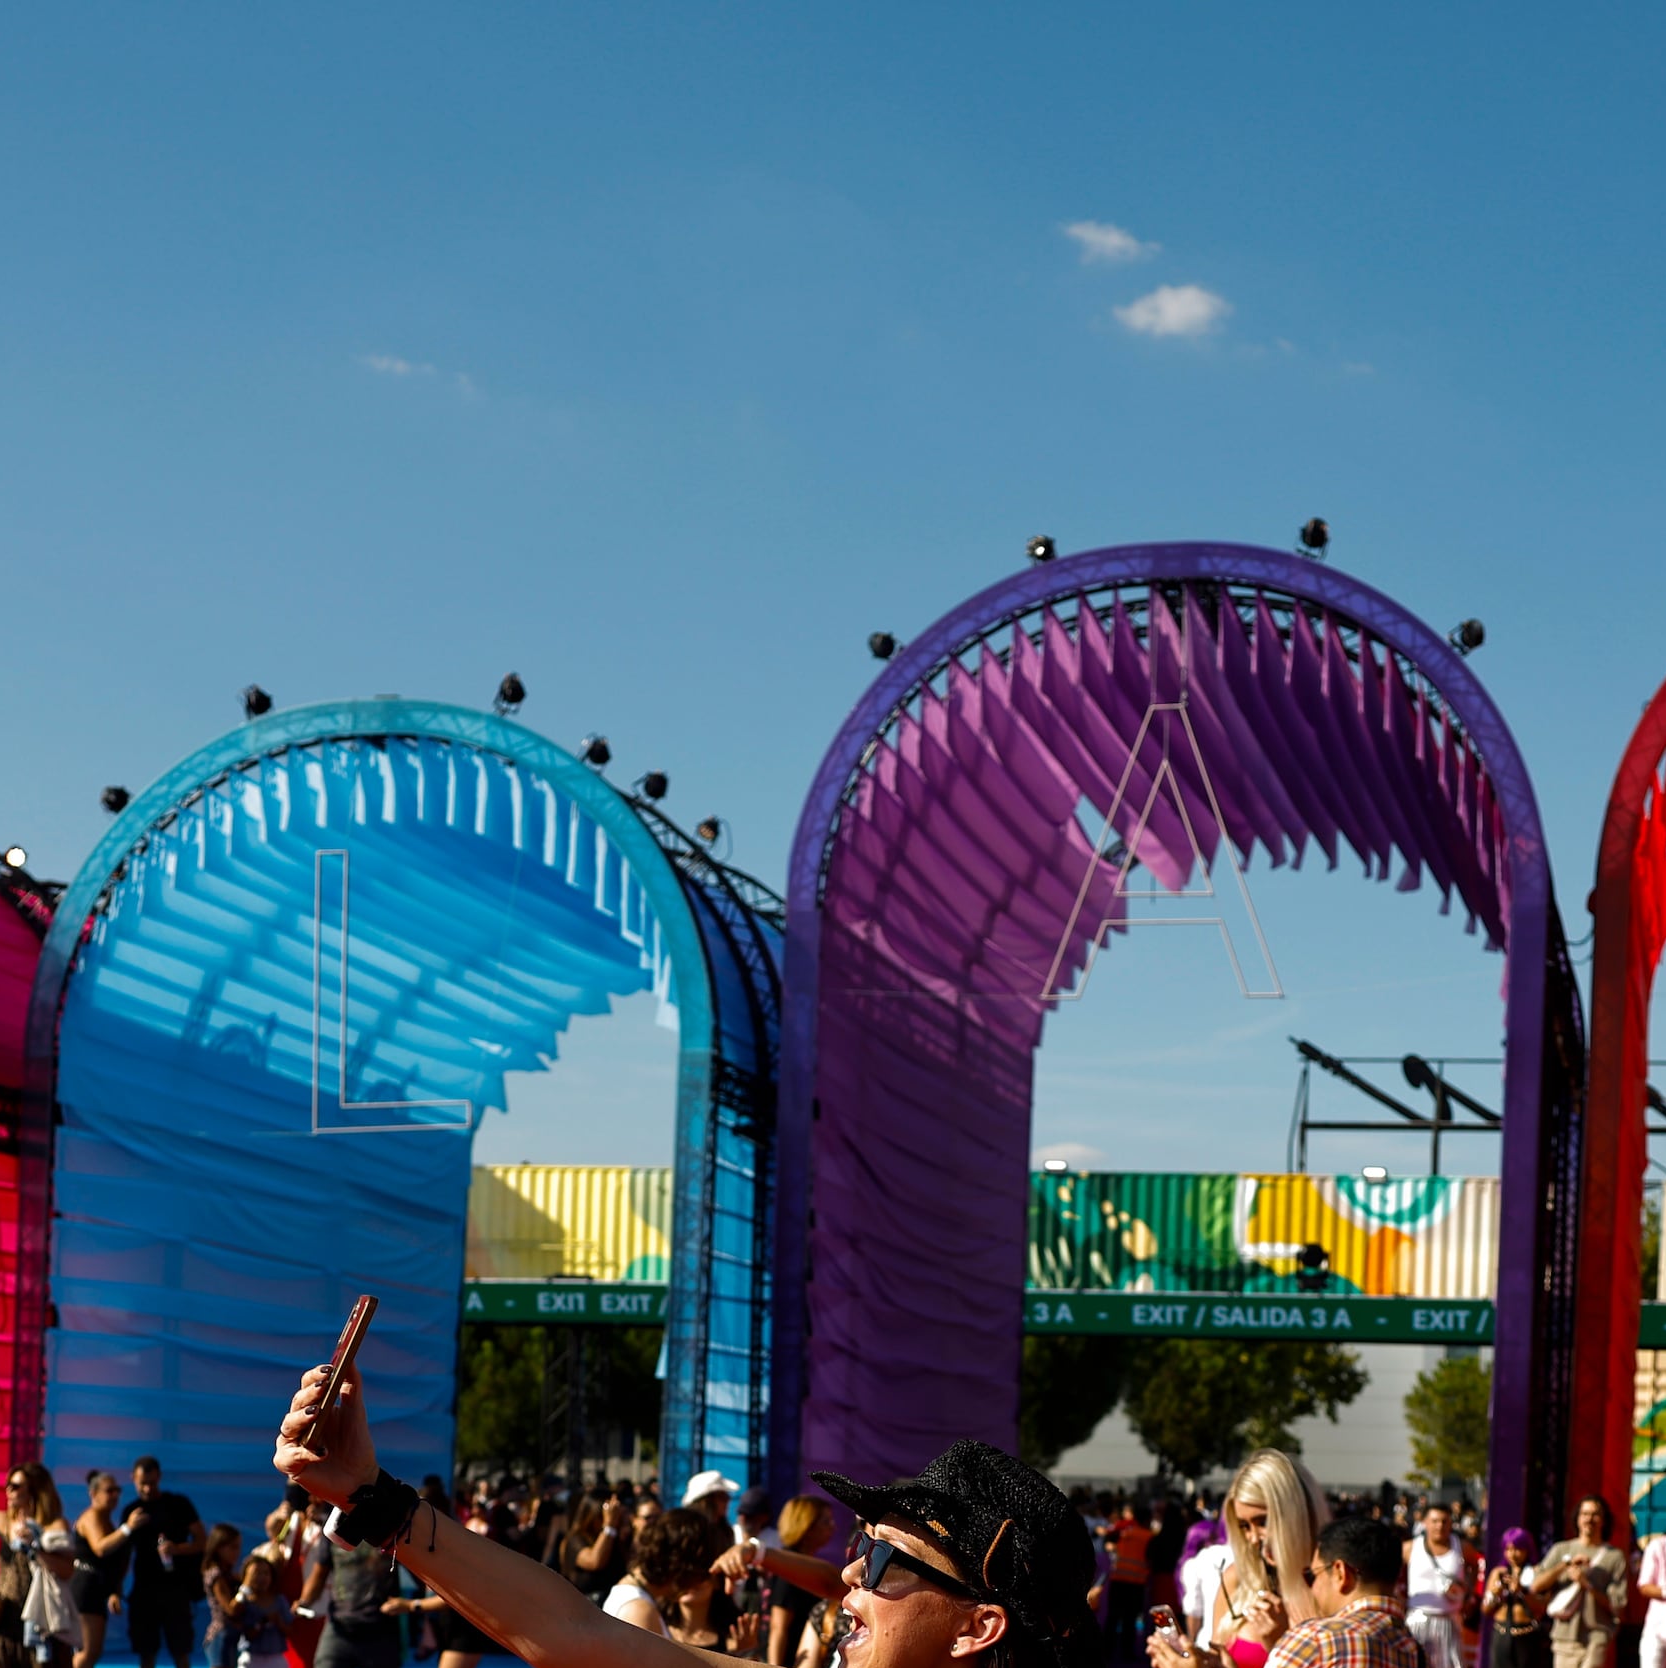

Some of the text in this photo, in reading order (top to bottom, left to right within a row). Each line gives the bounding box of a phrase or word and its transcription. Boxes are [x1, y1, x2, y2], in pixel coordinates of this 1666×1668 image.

[311, 849, 473, 1134] L
[1039, 702, 1284, 1000] A
[600, 1293, 653, 1314] EXIT
[1034, 1302, 1050, 1323] 3
[1055, 1302, 1074, 1323] A
[1132, 1304, 1188, 1325] EXIT
[1193, 1304, 1206, 1328] /
[1212, 1304, 1305, 1328] SALIDA
[1310, 1307, 1327, 1328] 3
[1333, 1307, 1352, 1328] A
[1412, 1309, 1471, 1330] EXIT
[1475, 1309, 1490, 1334] /
